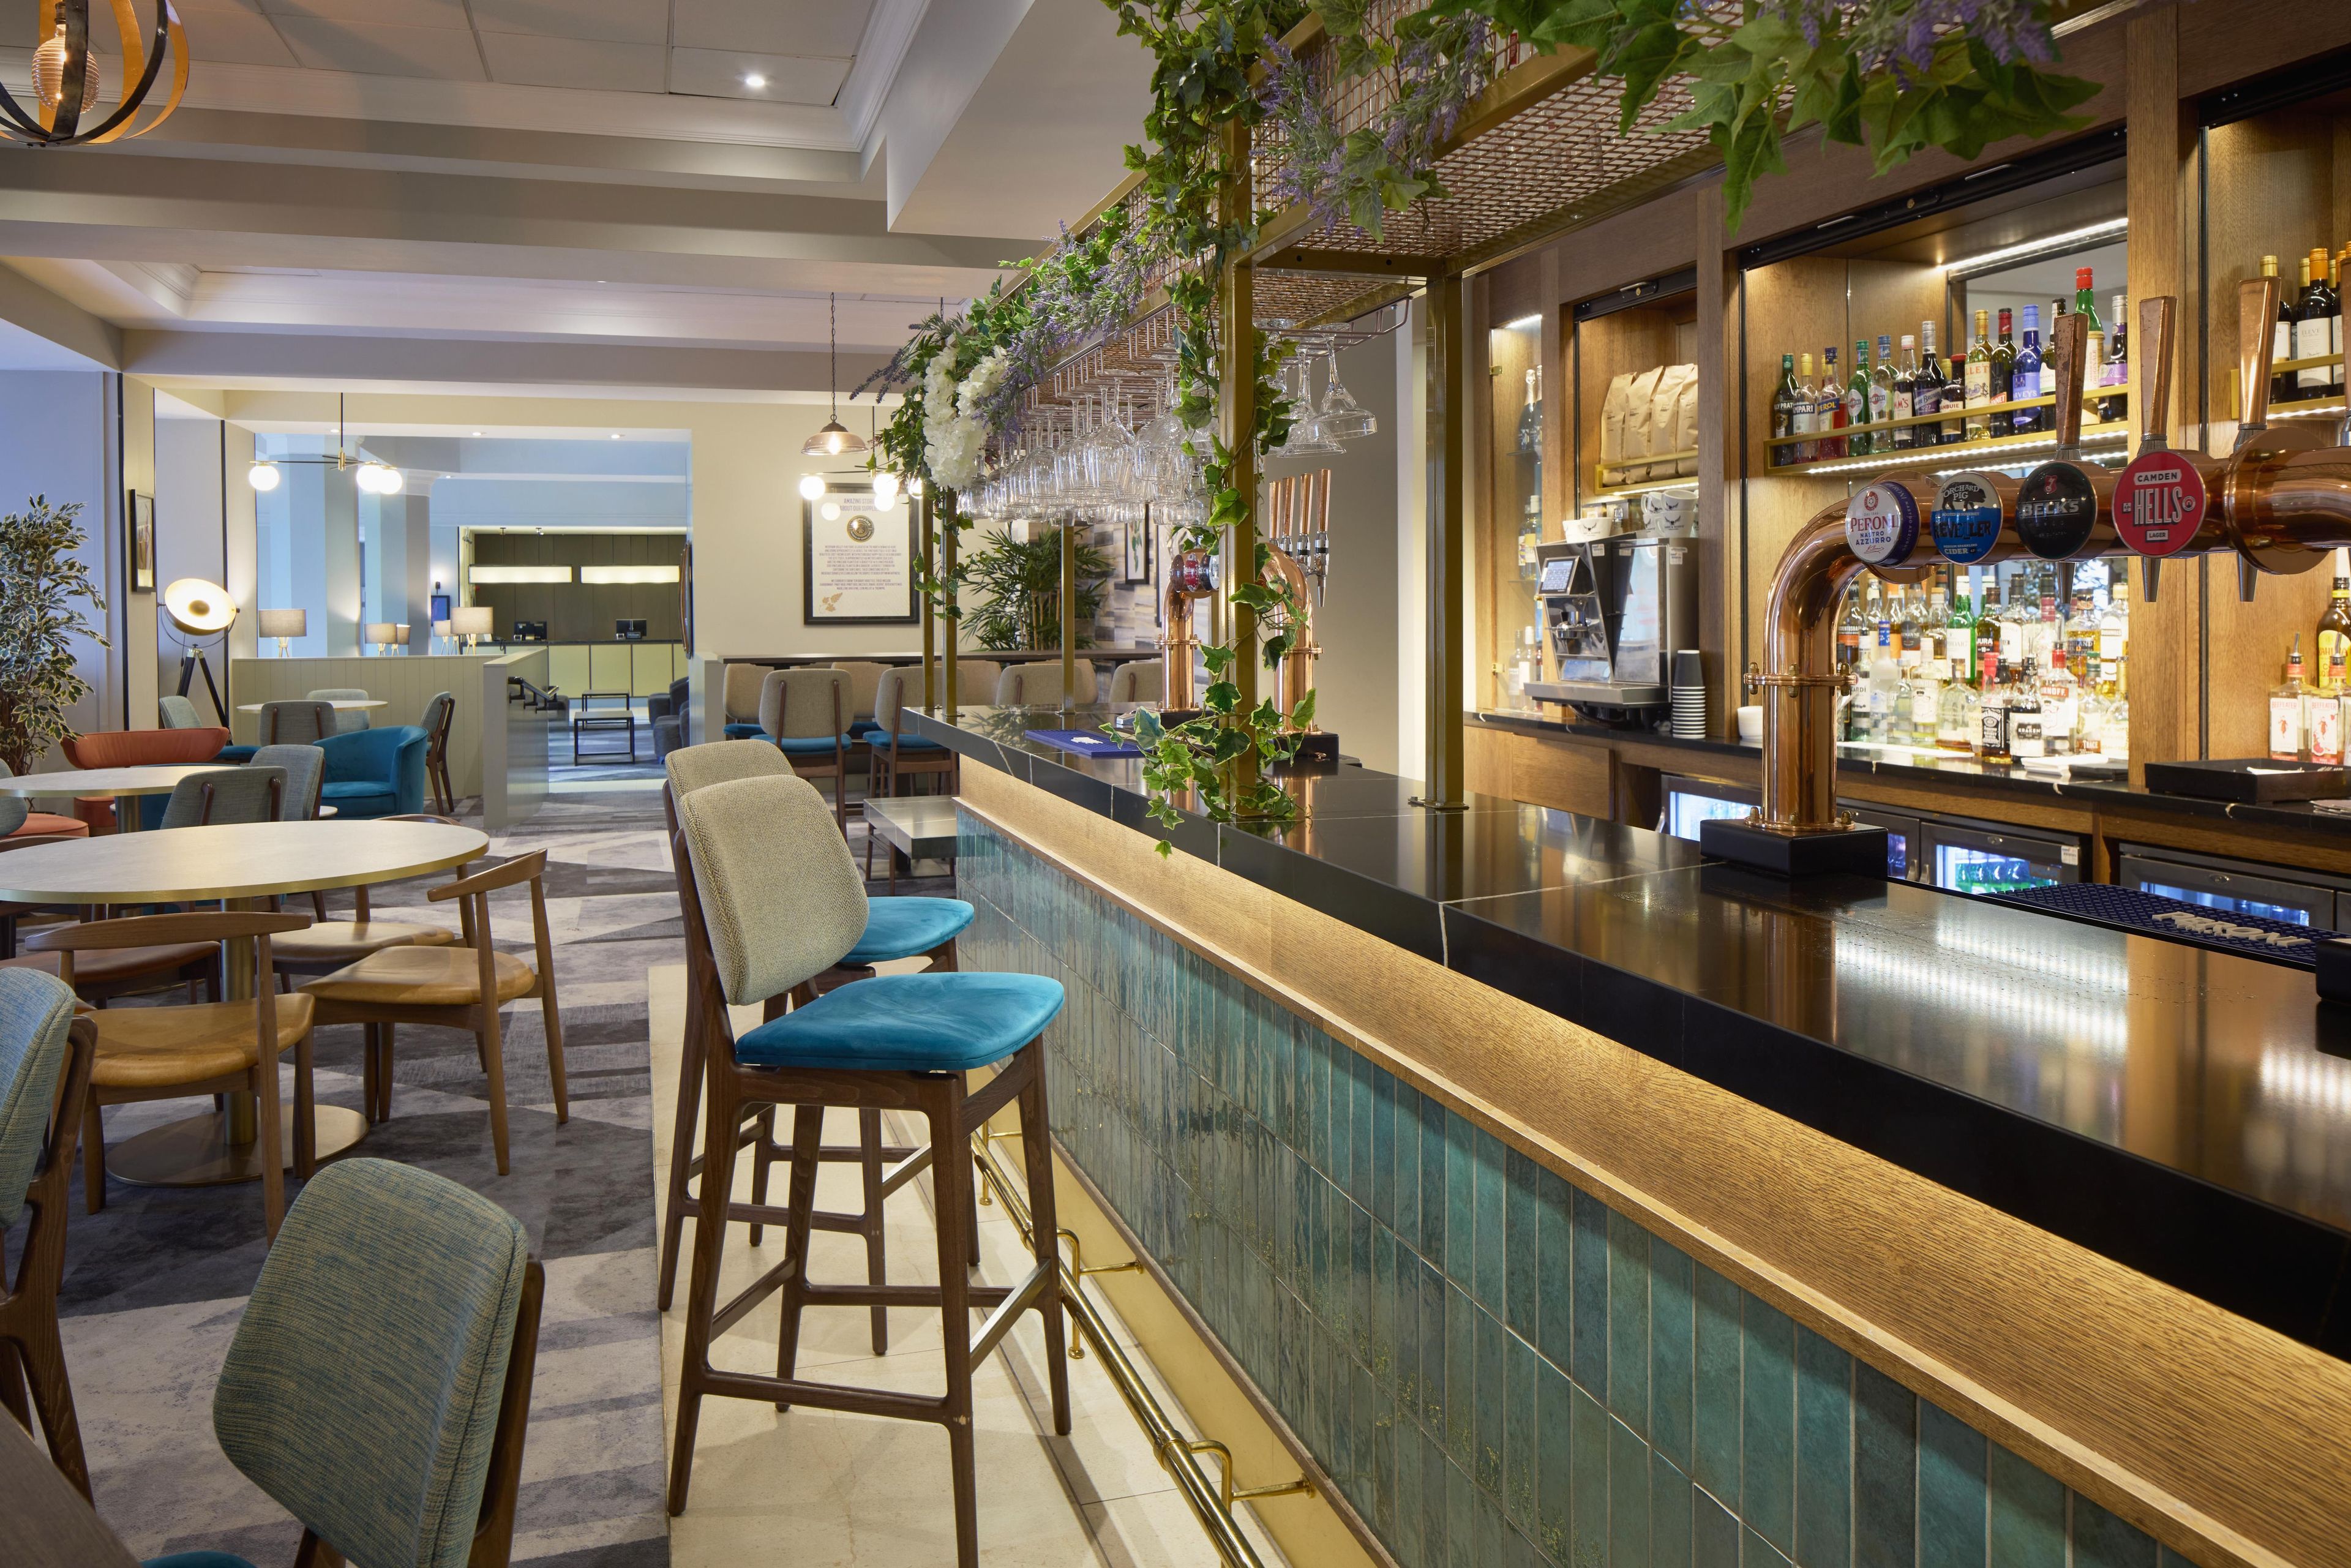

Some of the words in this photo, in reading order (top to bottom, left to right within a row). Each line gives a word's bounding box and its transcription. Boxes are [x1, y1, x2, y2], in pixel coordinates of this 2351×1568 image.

[2137, 472, 2178, 482] CAMDEN
[1944, 484, 1979, 498] ORCHARD
[1953, 492, 1969, 500] PIG
[2021, 499, 2079, 518] BECK'S
[2134, 486, 2183, 526] HELLS
[1851, 515, 1897, 532] PERONI
[1856, 537, 1891, 546] AZZURRO
[2152, 910, 2311, 948] PERONI
